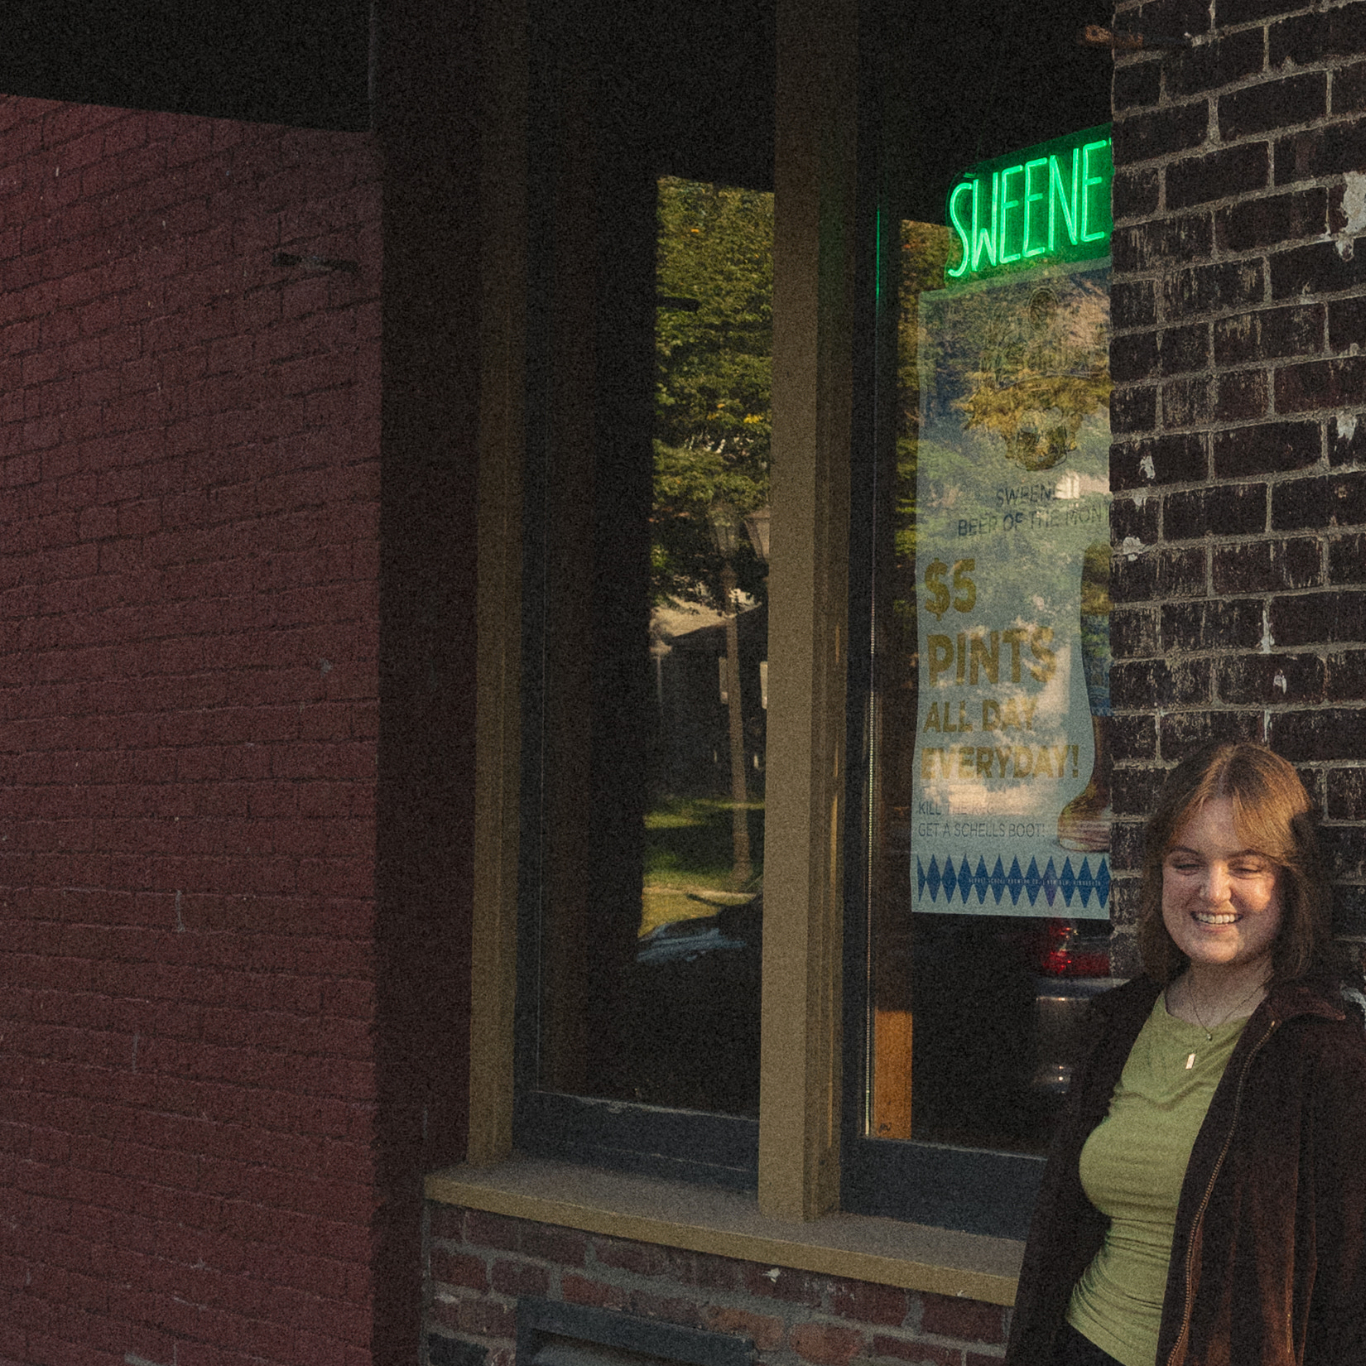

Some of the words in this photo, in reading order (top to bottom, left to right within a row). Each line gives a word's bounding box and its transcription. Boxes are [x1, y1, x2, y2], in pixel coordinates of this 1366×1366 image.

[924, 557, 977, 621] $5
[926, 625, 1058, 687] PINTS
[922, 700, 974, 734] ALL
[982, 696, 1038, 732] DAY
[920, 744, 1080, 780] EVERYDAY!
[918, 800, 942, 816] KILL
[918, 822, 940, 837] GET
[943, 822, 952, 837] A
